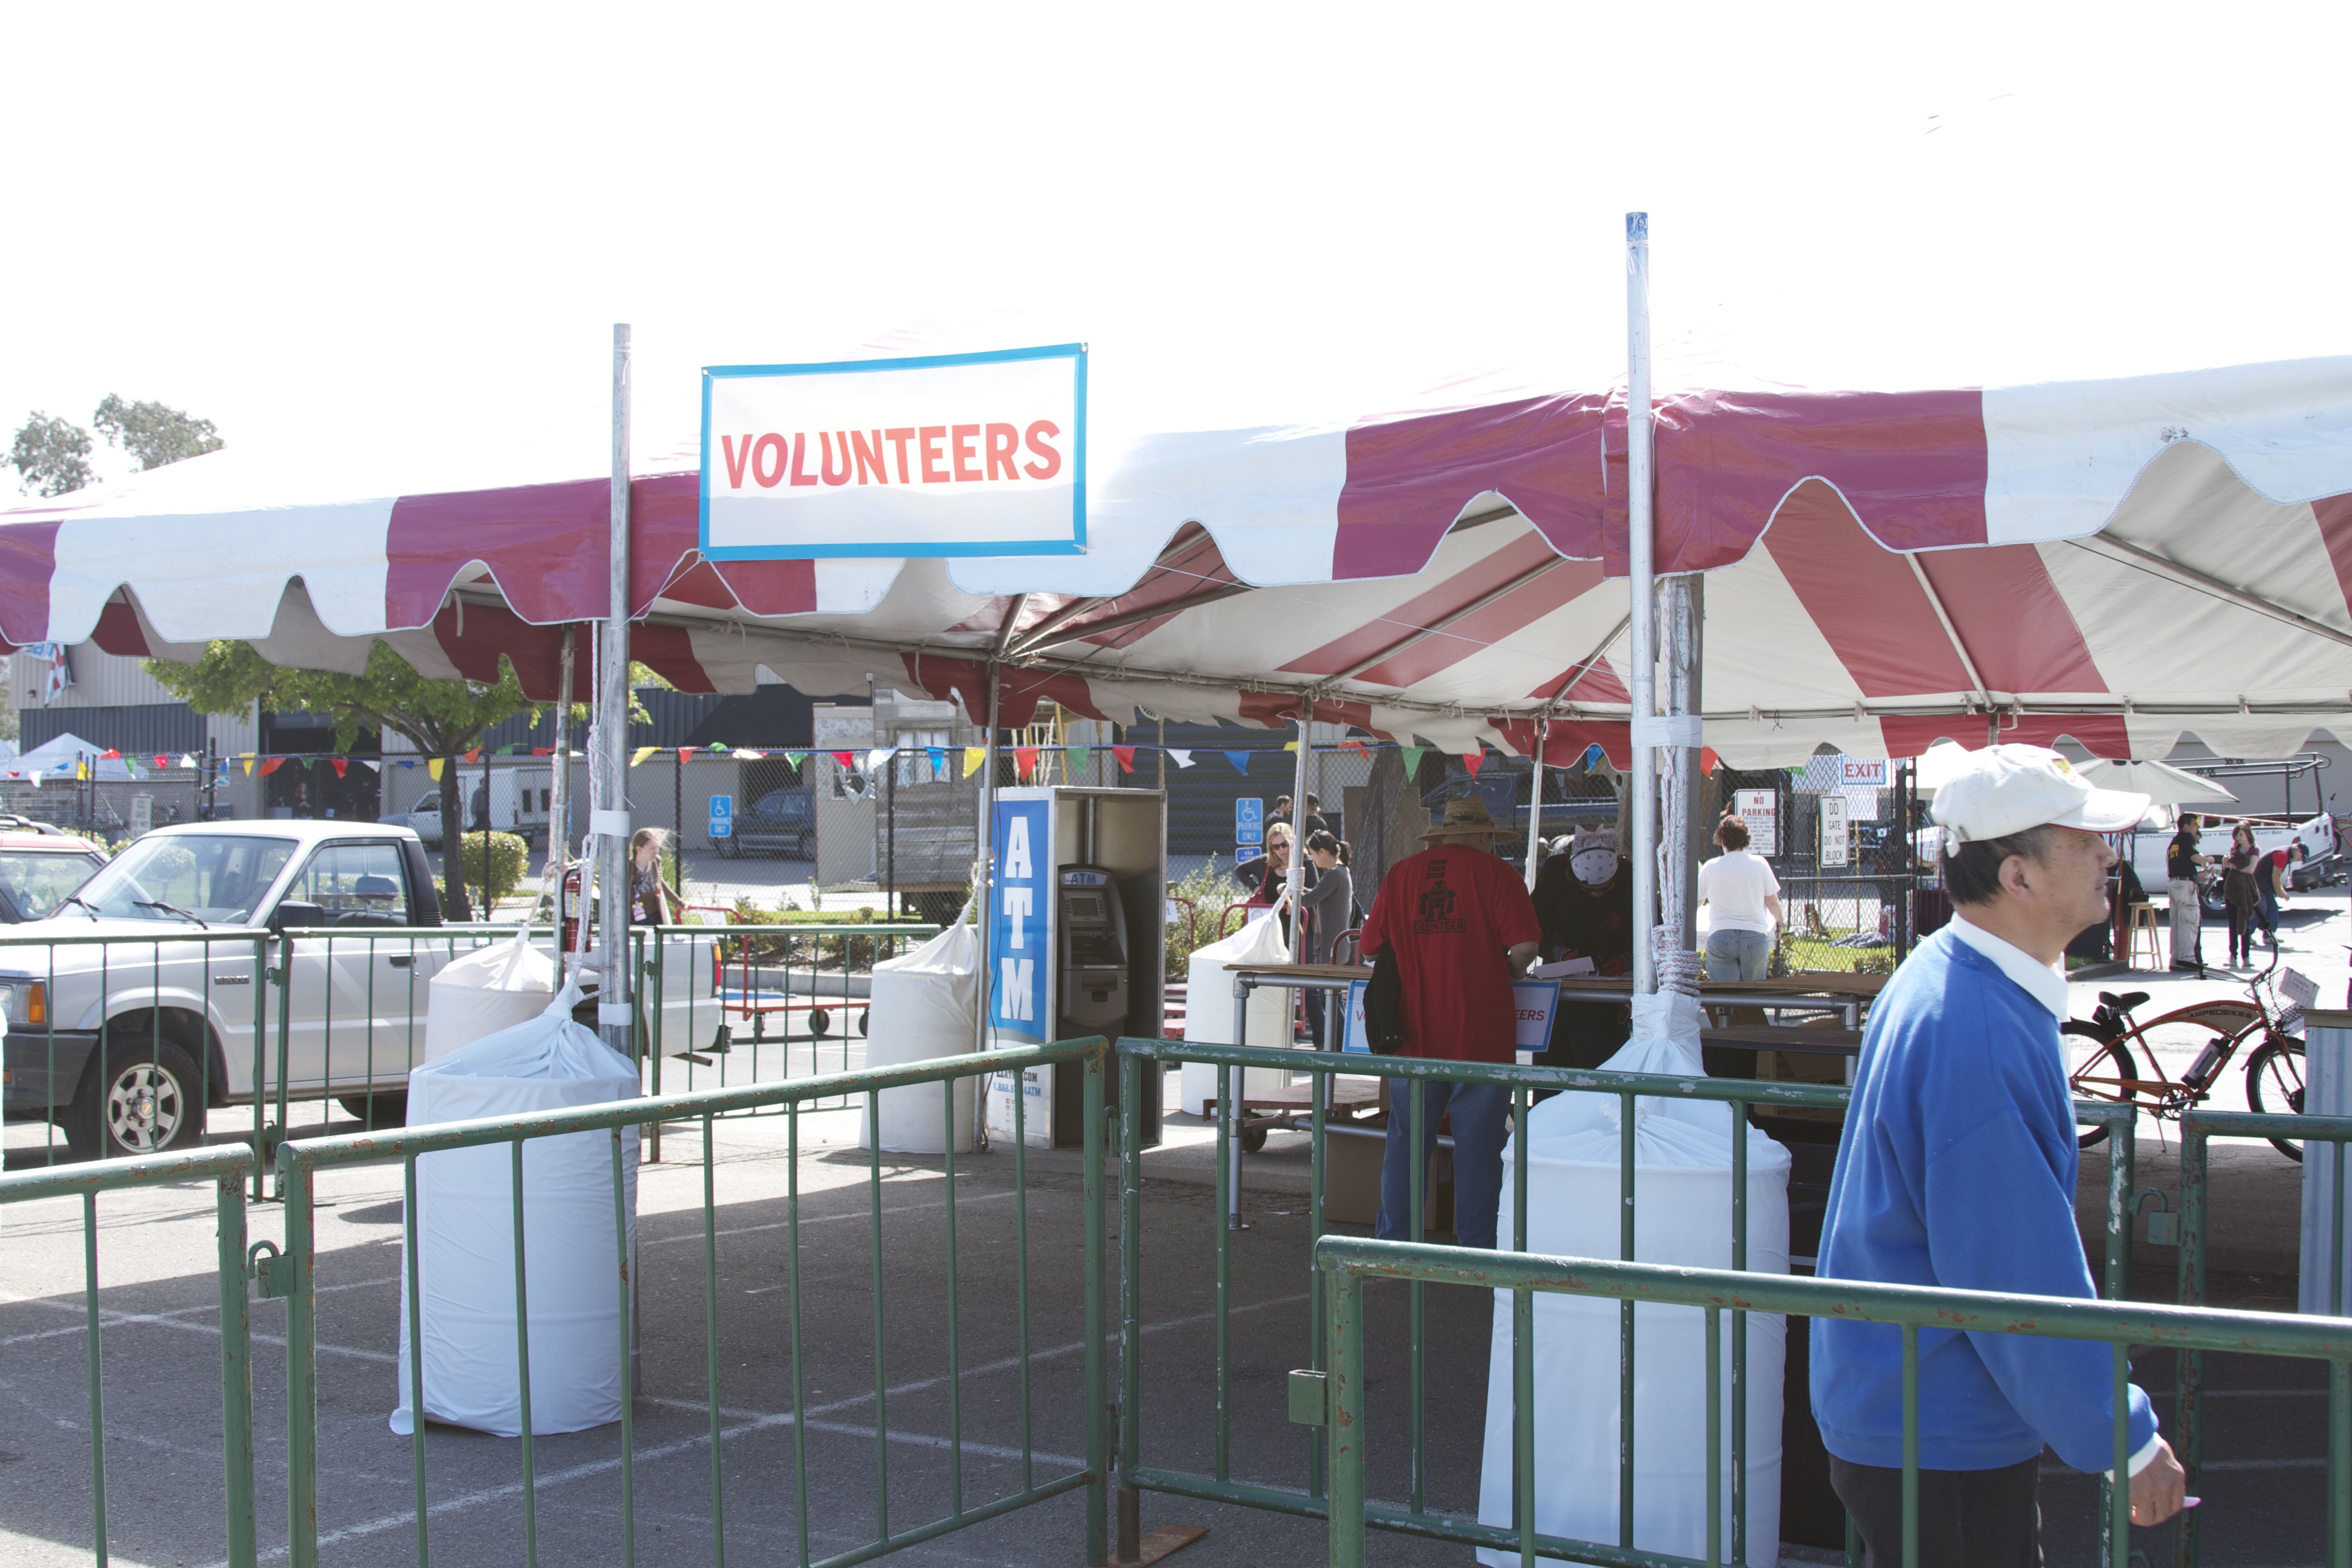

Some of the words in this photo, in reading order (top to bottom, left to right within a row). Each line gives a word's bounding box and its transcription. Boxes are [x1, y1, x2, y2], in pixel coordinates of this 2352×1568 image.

[721, 420, 1061, 489] VOLUNTEERS
[1844, 764, 1882, 777] EXIT
[1754, 796, 1764, 804] NO
[1742, 808, 1775, 816] PARKING
[1238, 822, 1261, 830] PARKING
[1828, 820, 1841, 830] GATE
[1243, 832, 1256, 841] ONLY
[1824, 836, 1832, 846] DO
[1834, 835, 1845, 845] NOT
[1826, 850, 1842, 860] BLOCK
[1071, 873, 1097, 884] ATM
[1000, 816, 1034, 1022] ATM
[2189, 1009, 2253, 1019] AMPEDBIKES
